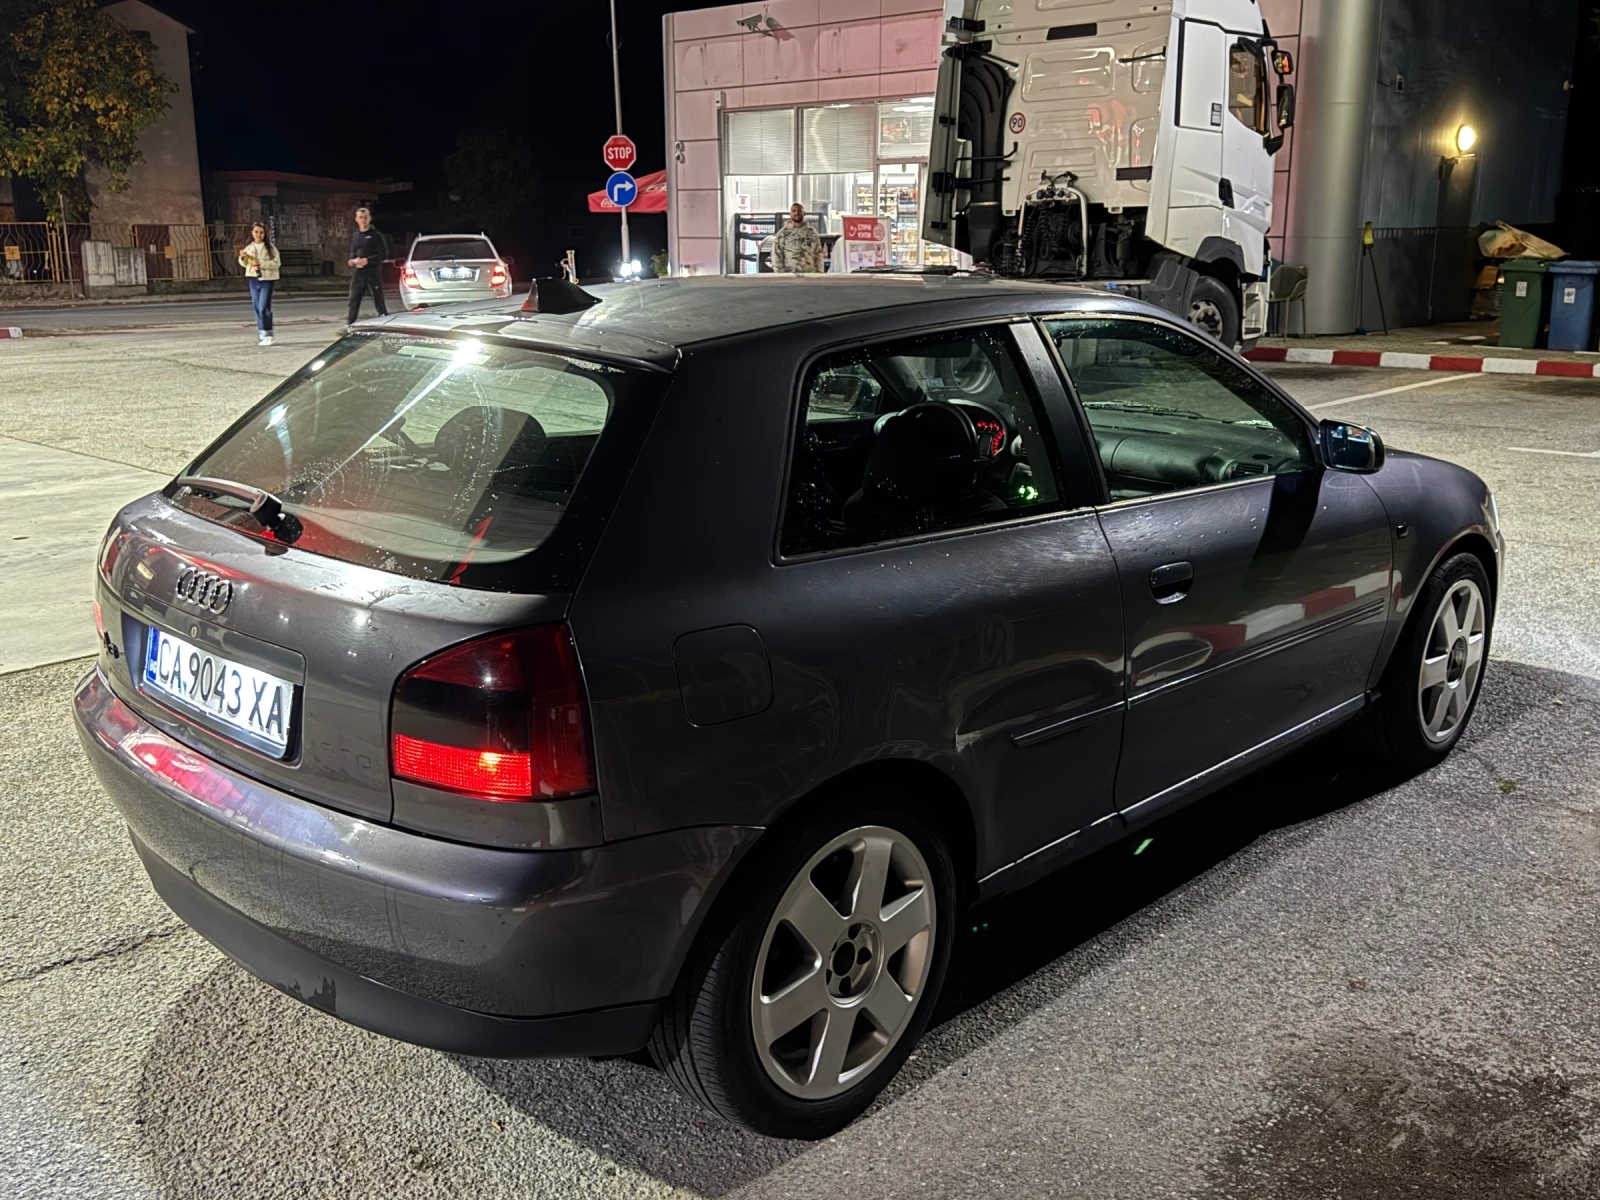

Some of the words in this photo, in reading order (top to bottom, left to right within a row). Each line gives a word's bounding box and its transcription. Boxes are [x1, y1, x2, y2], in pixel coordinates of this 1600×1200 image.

[1012, 117, 1023, 128] 90
[607, 147, 632, 159] STOP
[160, 639, 182, 690] CA
[188, 652, 242, 715] 9043
[248, 677, 283, 735] XA
